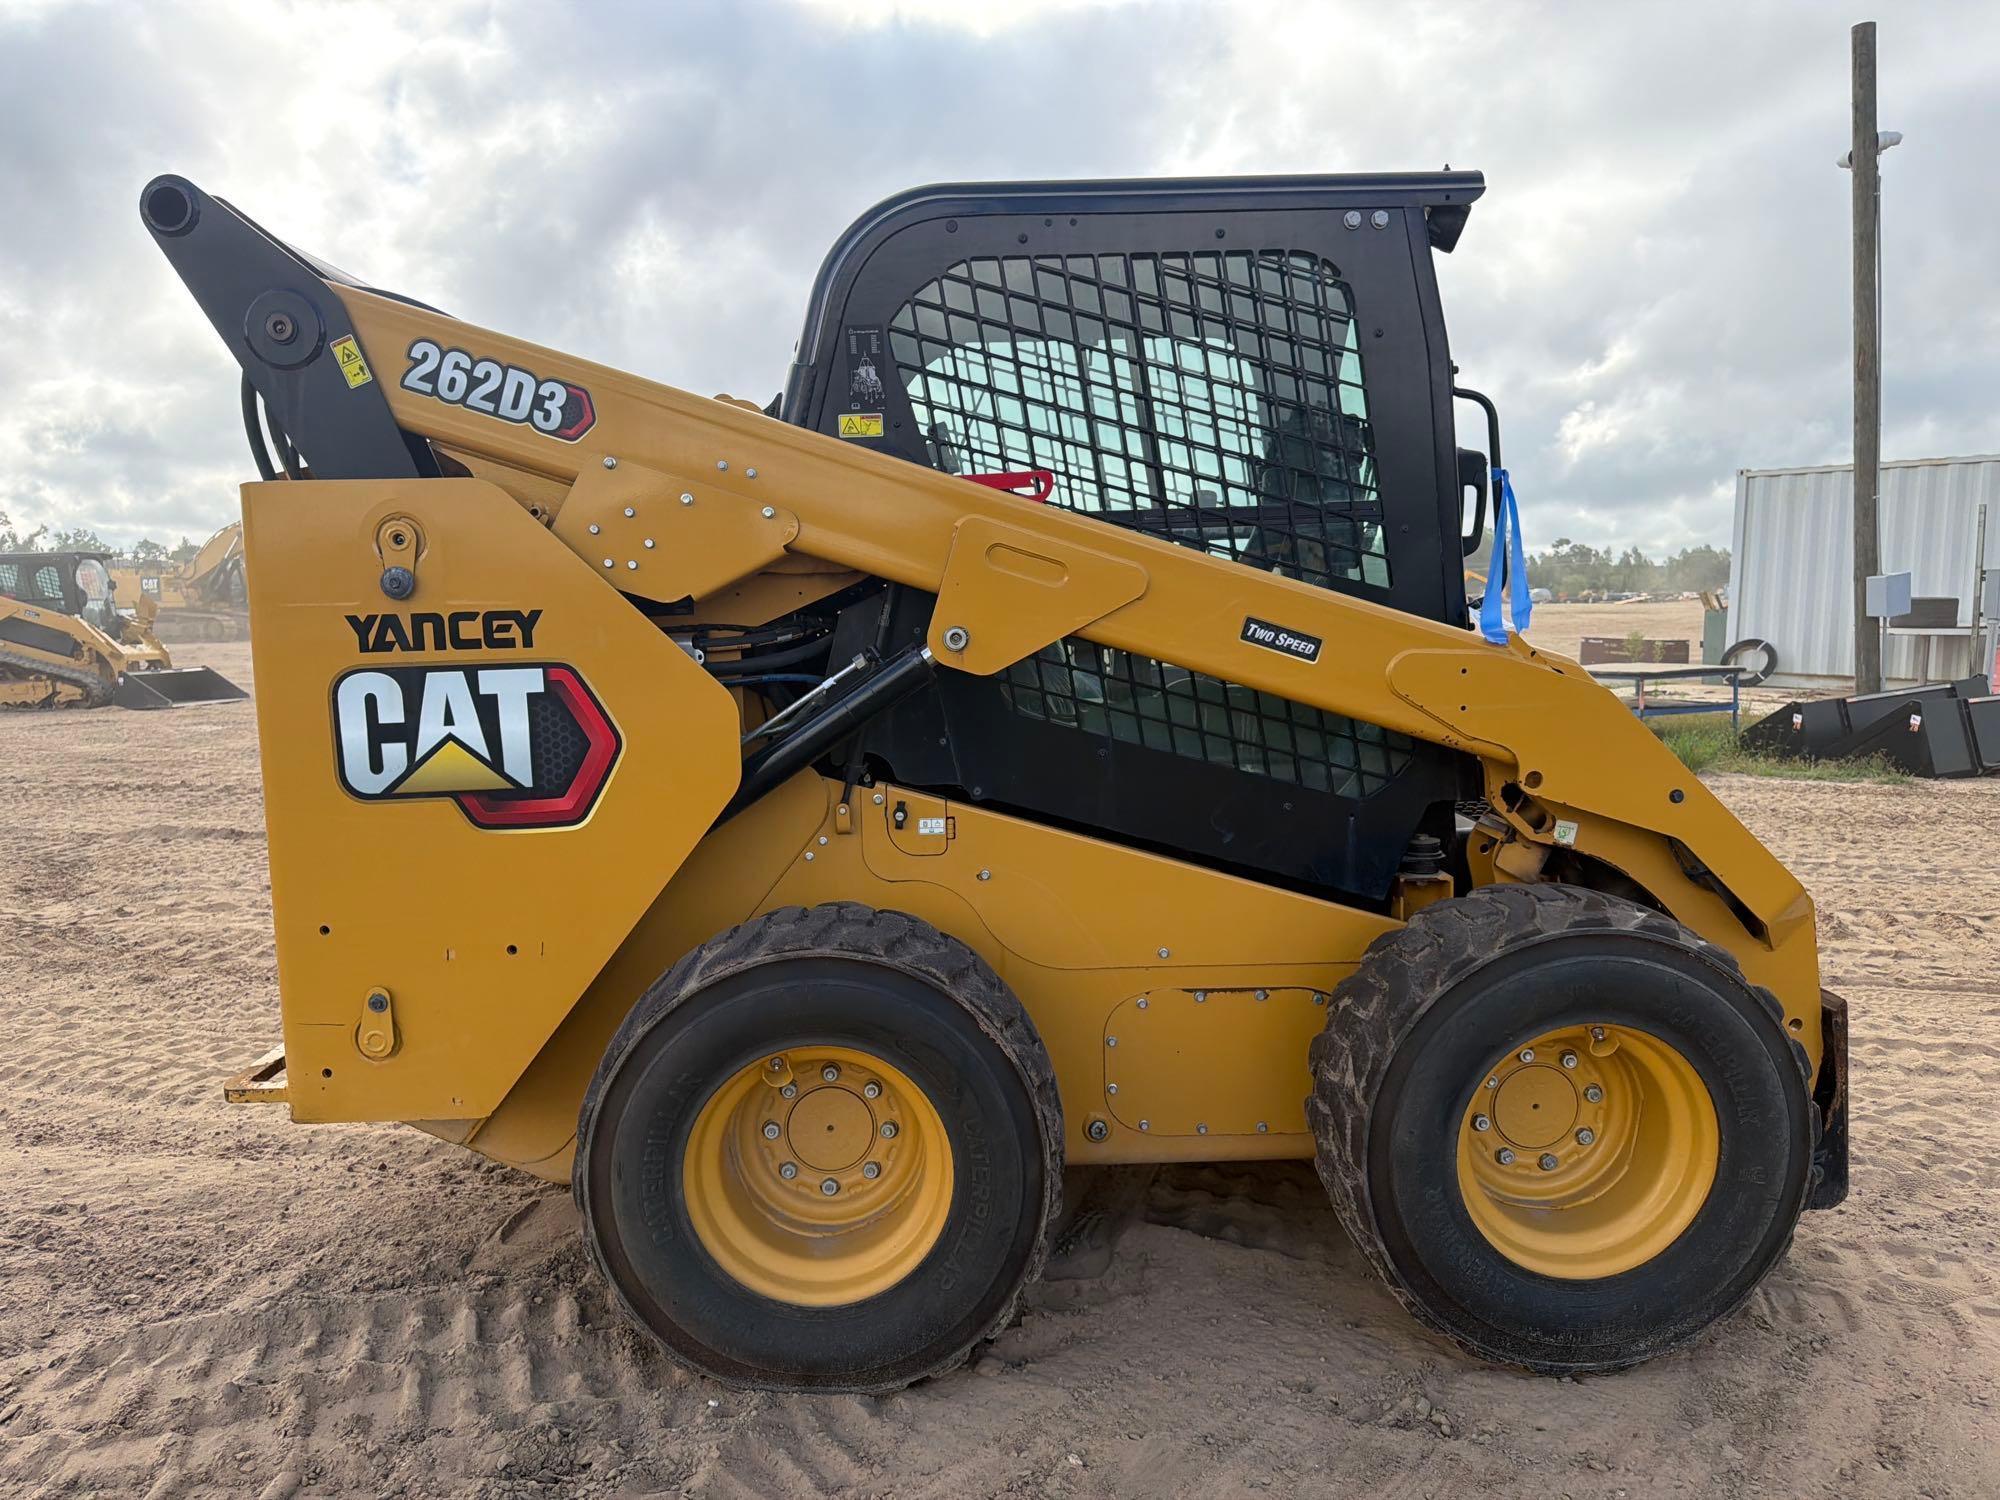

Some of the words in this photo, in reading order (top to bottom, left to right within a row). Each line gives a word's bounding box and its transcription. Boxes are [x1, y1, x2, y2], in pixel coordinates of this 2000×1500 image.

[403, 341, 567, 432] 262D3
[142, 579, 158, 589] CAT
[345, 609, 543, 653] YANCEY
[337, 668, 545, 795] CAT
[936, 1117, 995, 1292] CATERPILLAR
